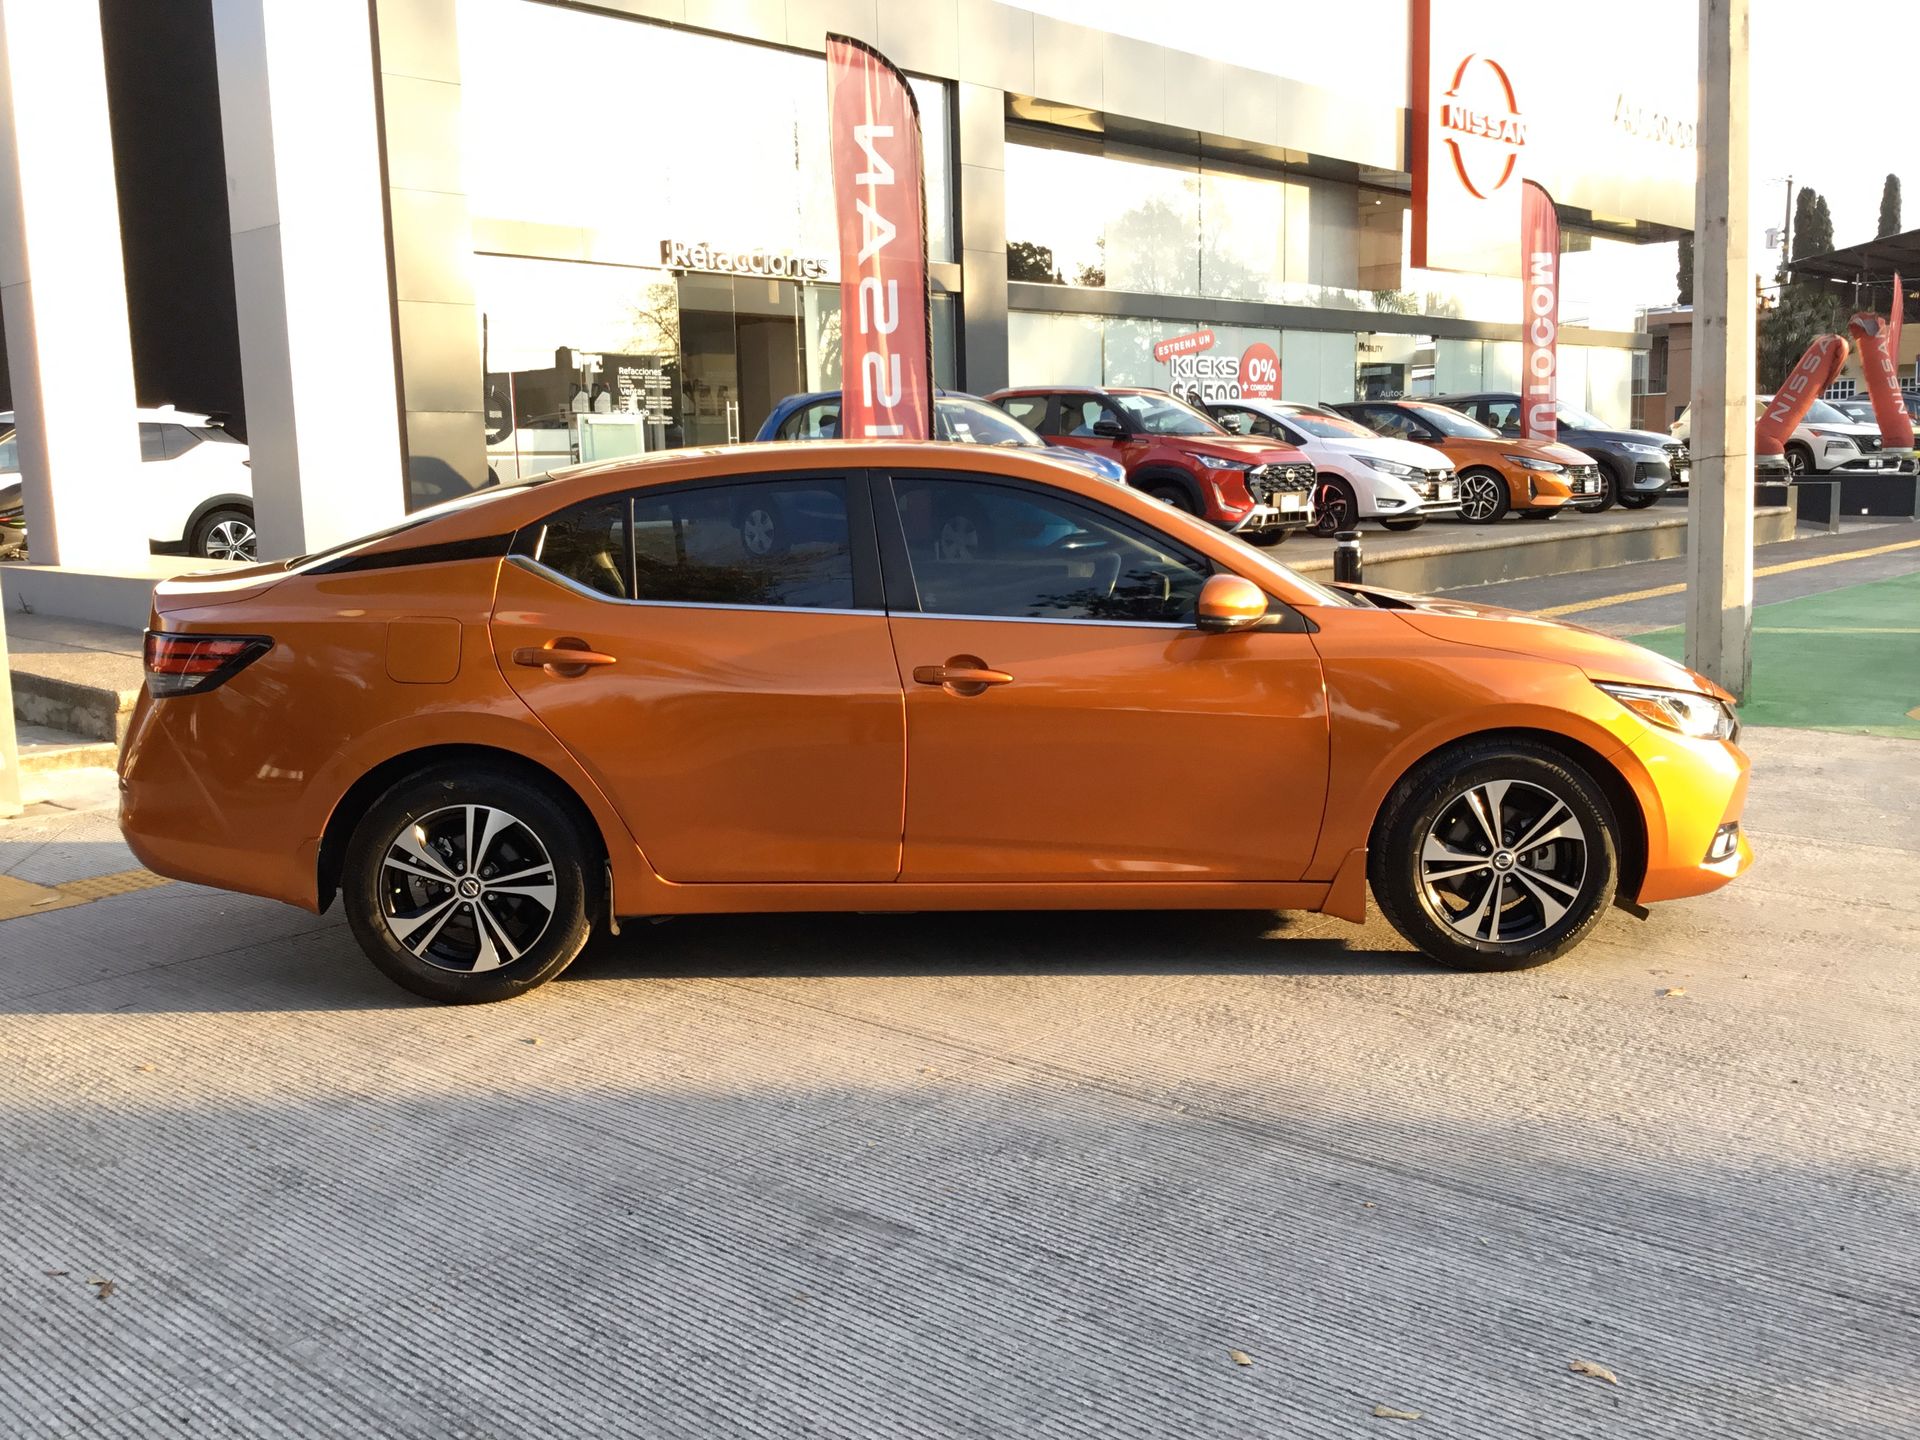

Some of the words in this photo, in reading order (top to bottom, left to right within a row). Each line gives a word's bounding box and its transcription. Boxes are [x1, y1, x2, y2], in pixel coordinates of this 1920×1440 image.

[1442, 104, 1527, 146] NISSAN
[661, 240, 830, 279] Refacciones
[1158, 338, 1197, 356] ESTRENA
[1198, 334, 1210, 346] UN
[619, 367, 662, 376] Refacciones
[1171, 355, 1240, 379] KICKS
[1248, 358, 1277, 382] 0%
